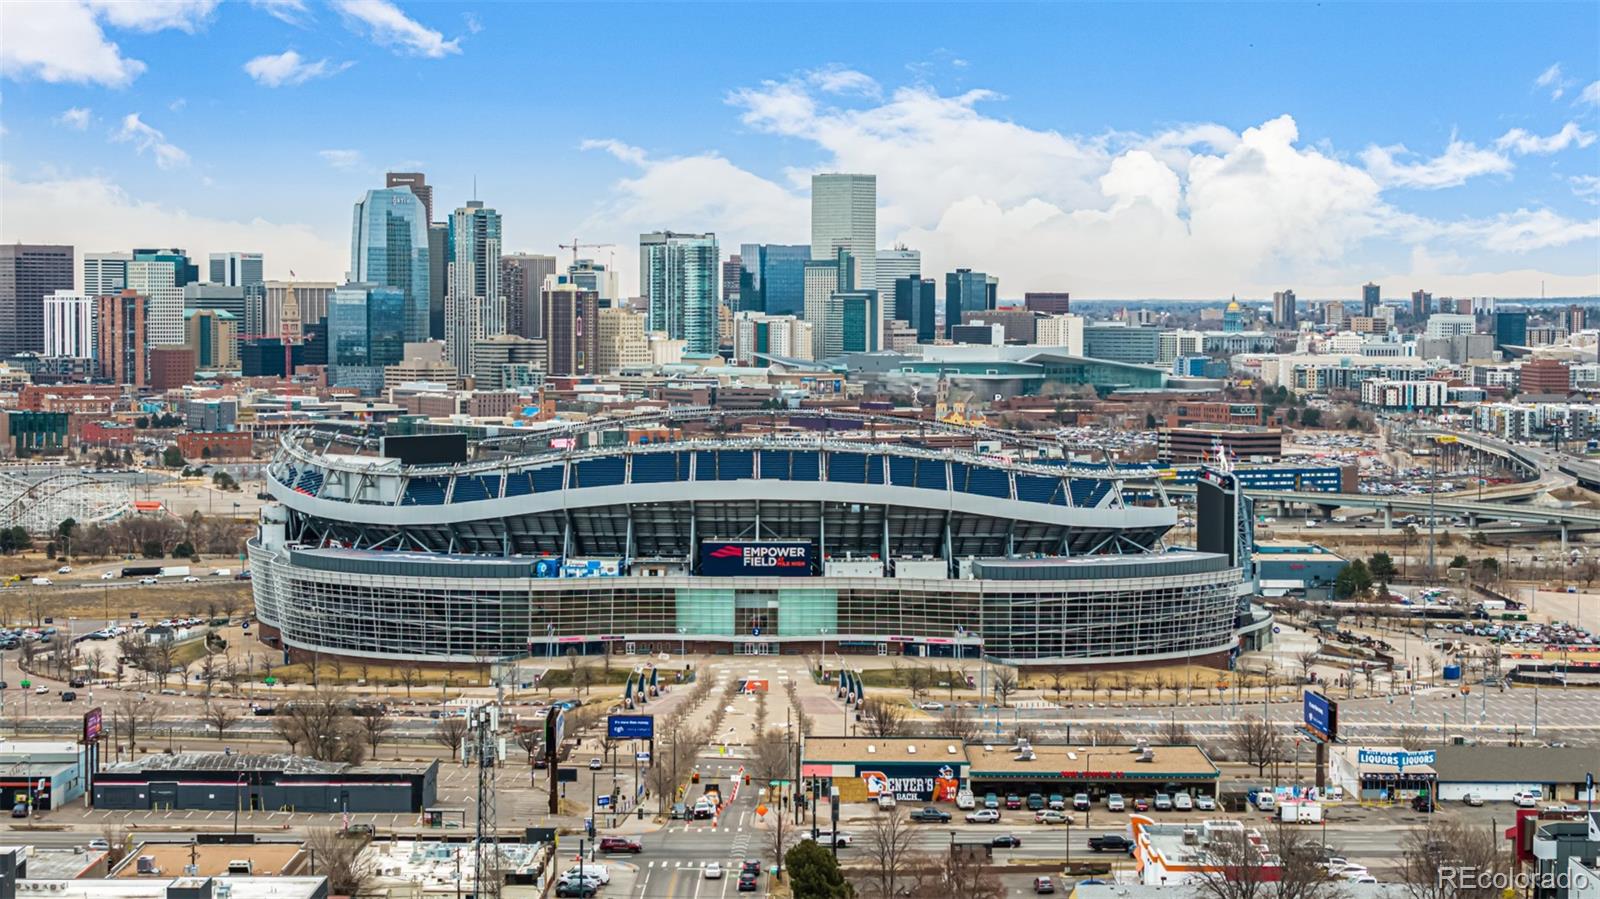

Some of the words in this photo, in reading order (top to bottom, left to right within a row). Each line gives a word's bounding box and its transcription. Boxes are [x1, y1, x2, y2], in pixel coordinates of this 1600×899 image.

[743, 547, 805, 557] EMPOWER
[743, 557, 777, 567] FIELD
[1361, 754, 1399, 765] LIQUORS
[1402, 754, 1434, 765] LIQUORS
